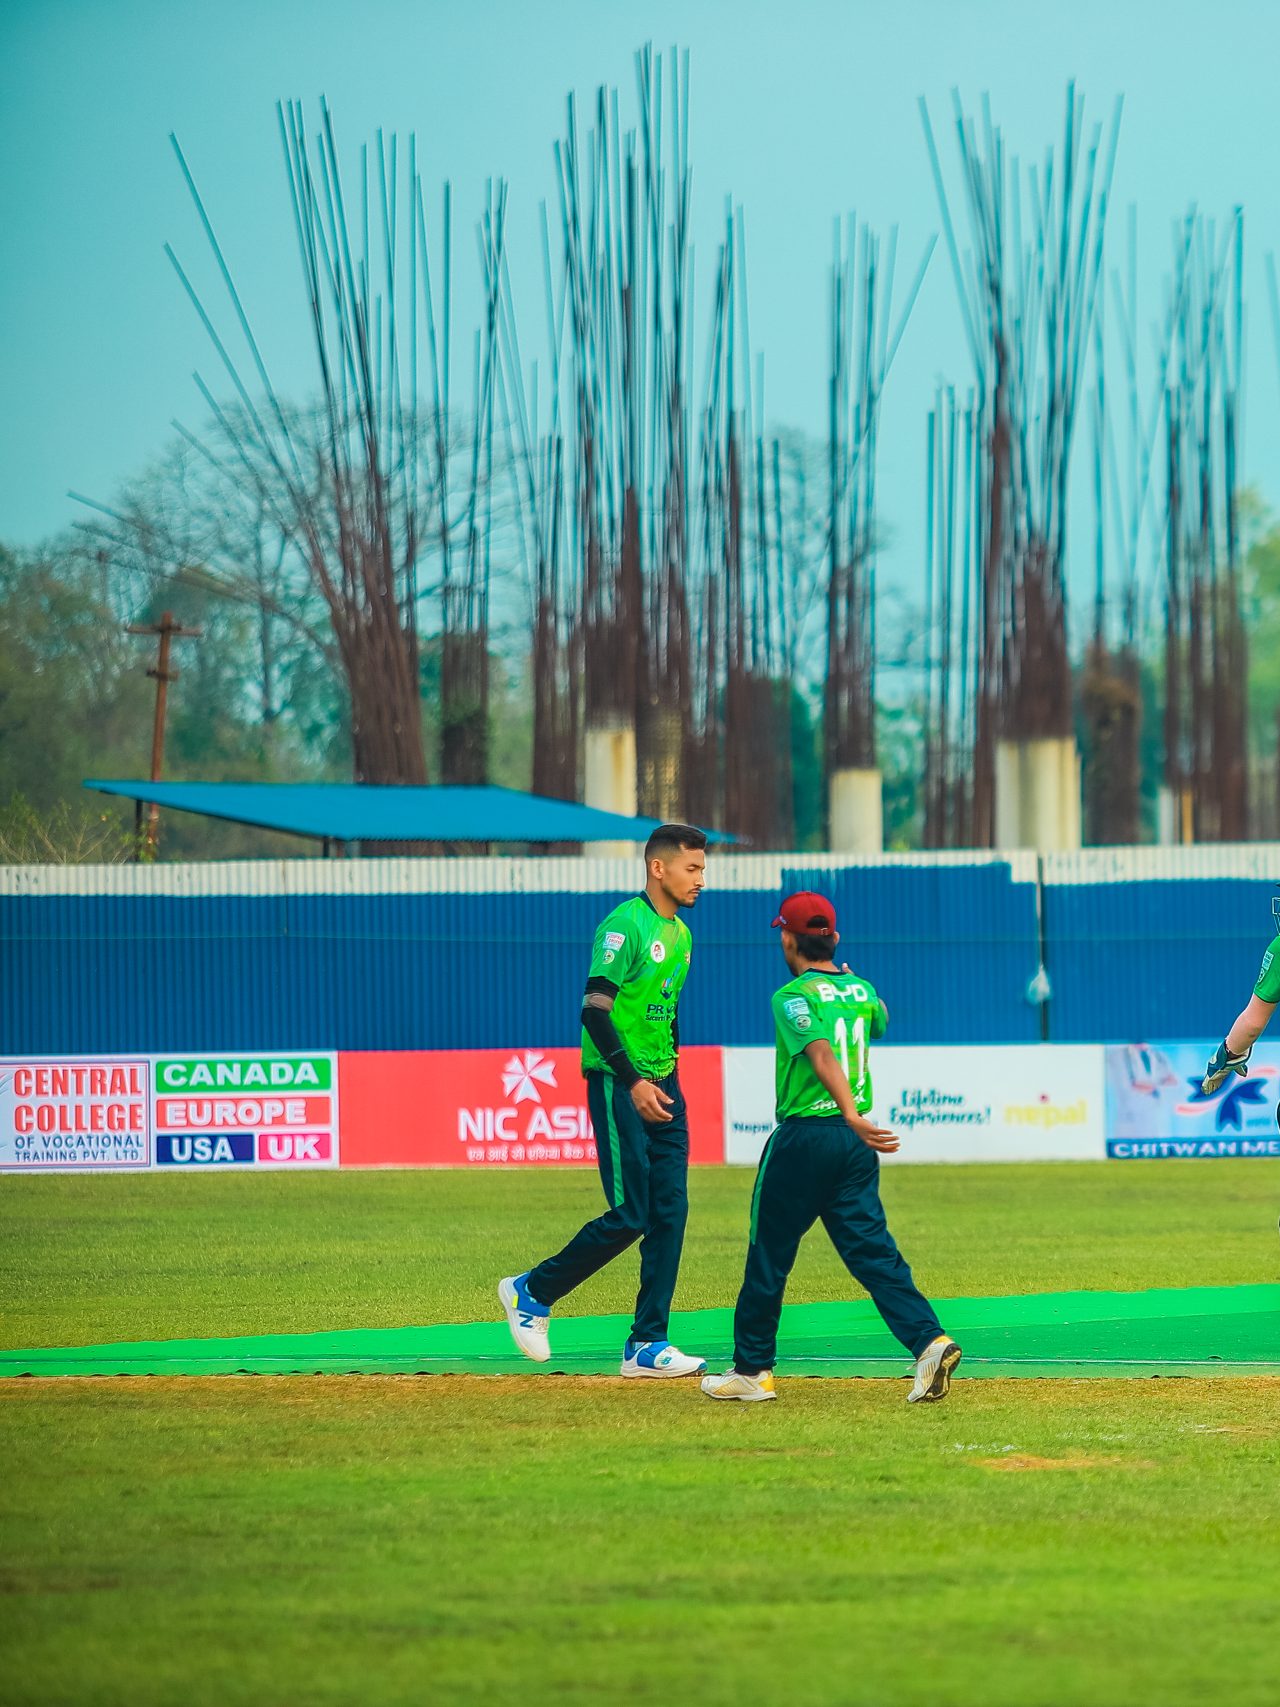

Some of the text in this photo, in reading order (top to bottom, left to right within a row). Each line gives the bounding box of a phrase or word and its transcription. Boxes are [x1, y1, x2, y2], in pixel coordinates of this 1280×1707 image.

[816, 983, 868, 1003] BYD
[834, 1017, 866, 1089] 11
[14, 1067, 144, 1097] CENTRAL
[163, 1061, 320, 1087] CANADA
[901, 1089, 964, 1108] Lifetime
[14, 1103, 144, 1133] COLLEGE
[166, 1100, 307, 1127] EUROPE
[458, 1107, 519, 1141] NIC
[15, 1134, 145, 1149] OF VOCATIONAL
[171, 1135, 322, 1162] USA UK
[1114, 1141, 1237, 1157] CHITWAN
[15, 1149, 144, 1163] TRAINING PVT. LTD.
